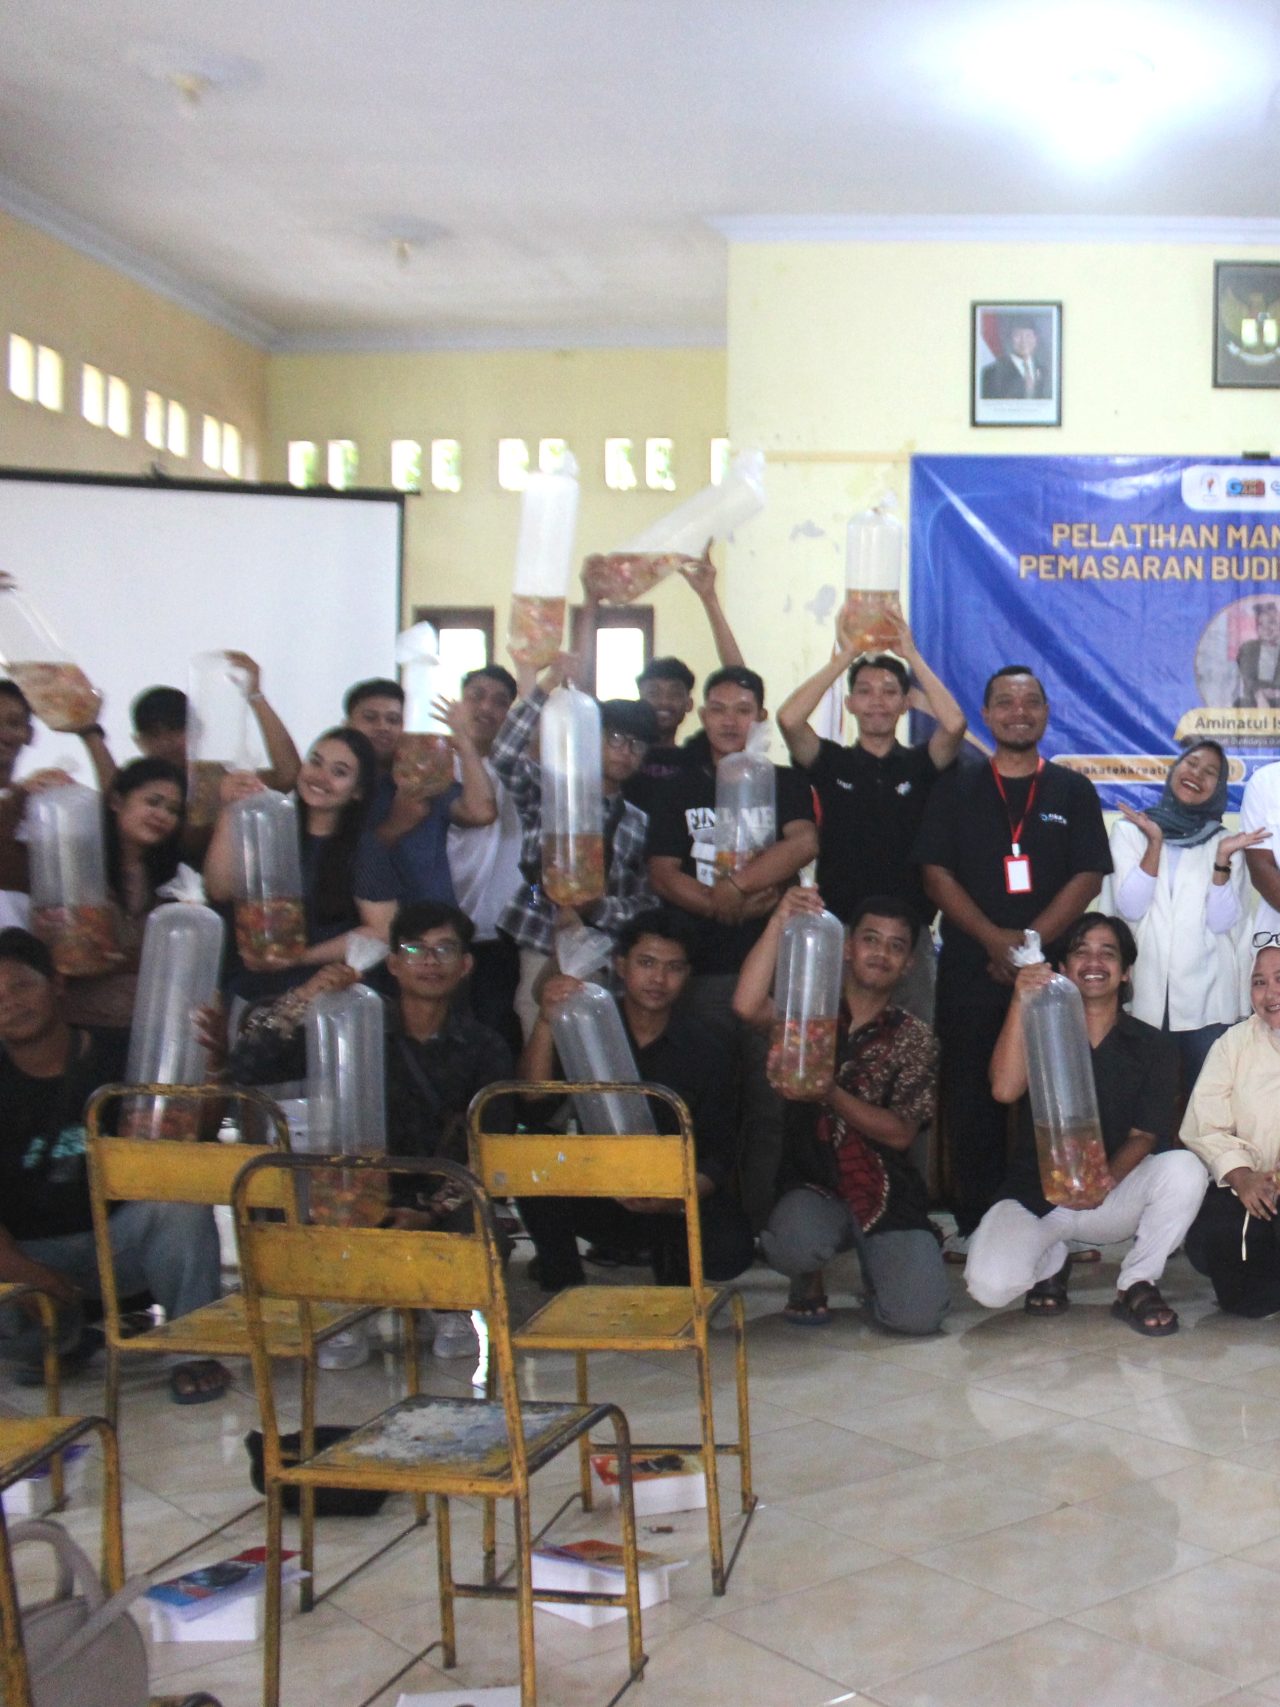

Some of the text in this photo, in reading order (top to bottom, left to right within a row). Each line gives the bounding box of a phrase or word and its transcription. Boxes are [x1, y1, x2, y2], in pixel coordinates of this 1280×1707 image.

[1051, 522, 1219, 549] PELATIHAN
[1018, 554, 1203, 581] PEMASARAN
[1194, 715, 1268, 730] Aminatul
